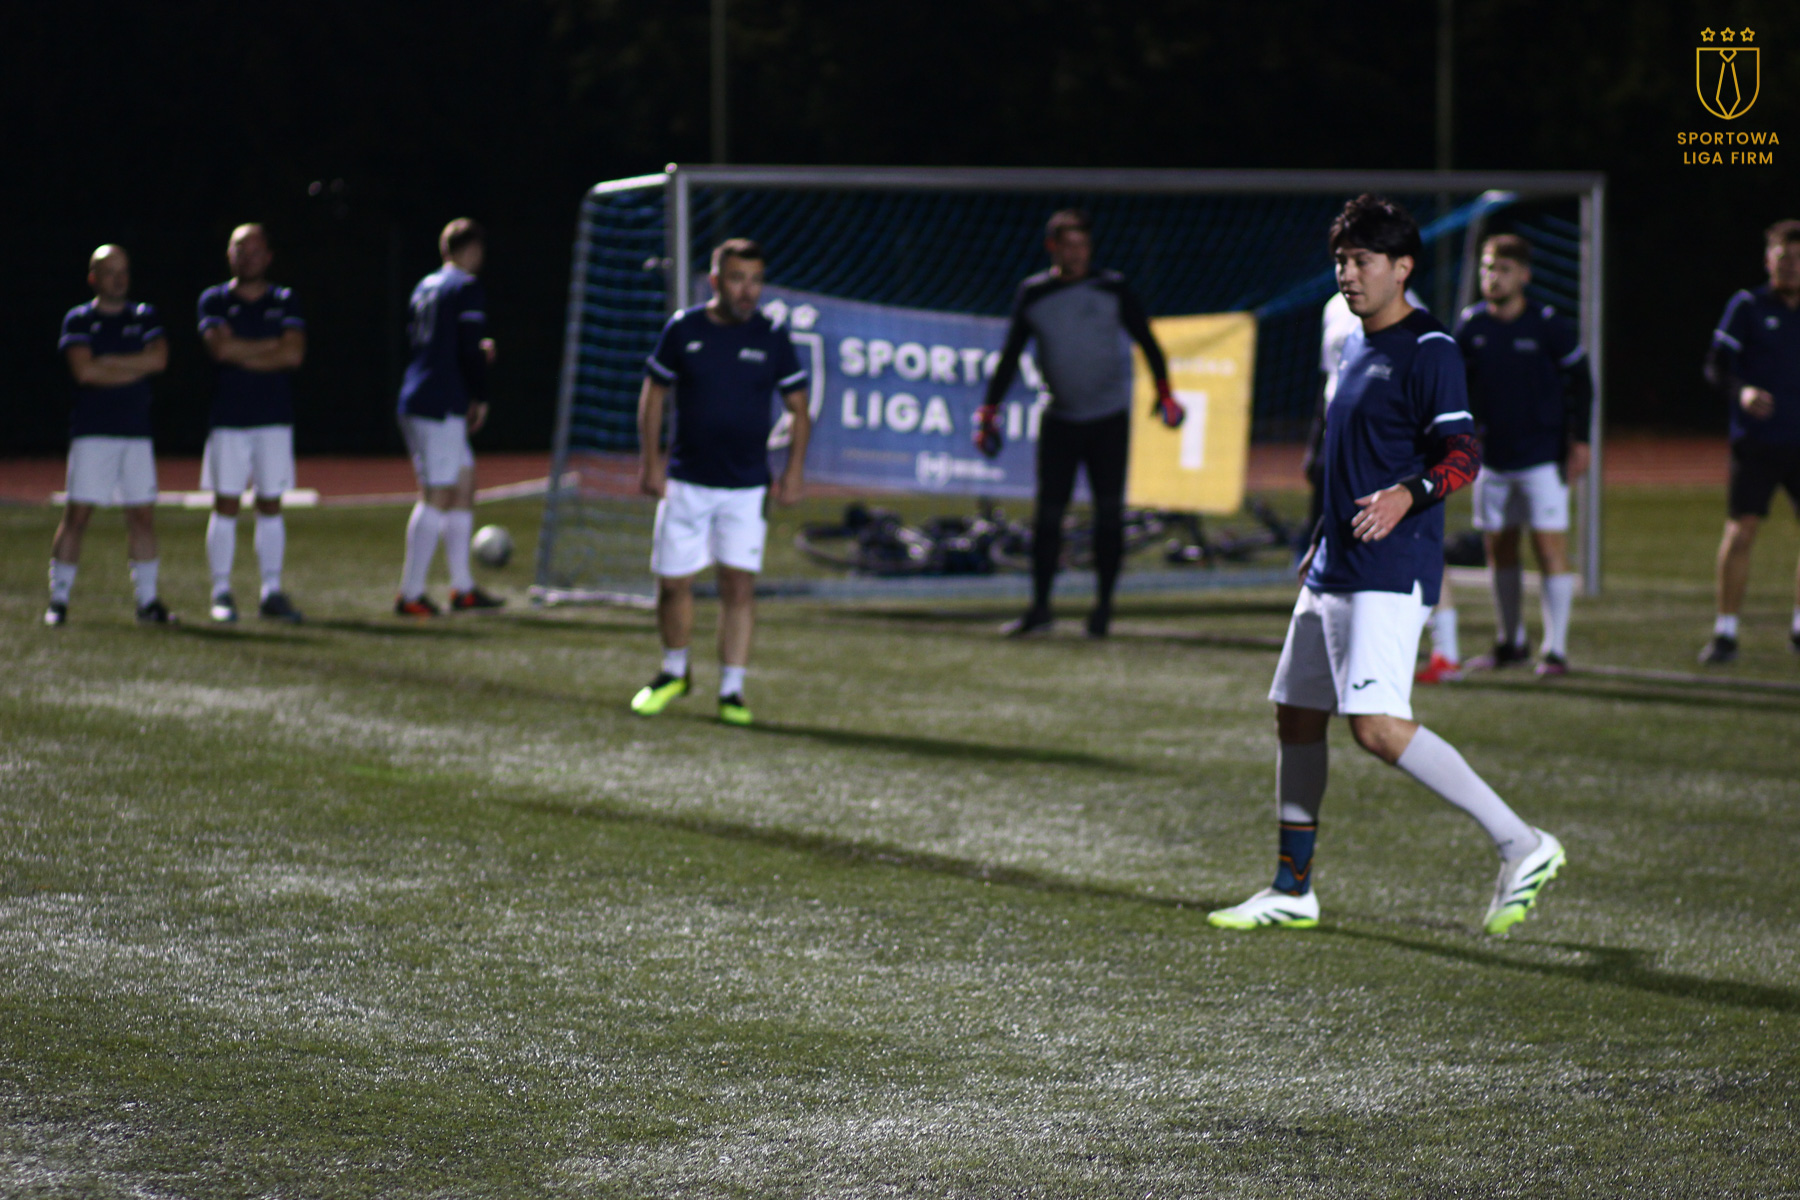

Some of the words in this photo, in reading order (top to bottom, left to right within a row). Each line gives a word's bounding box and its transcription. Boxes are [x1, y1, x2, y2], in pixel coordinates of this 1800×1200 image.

[839, 336, 1042, 389] SPORT
[842, 388, 953, 435] LIGA
[1172, 389, 1208, 470] 1
